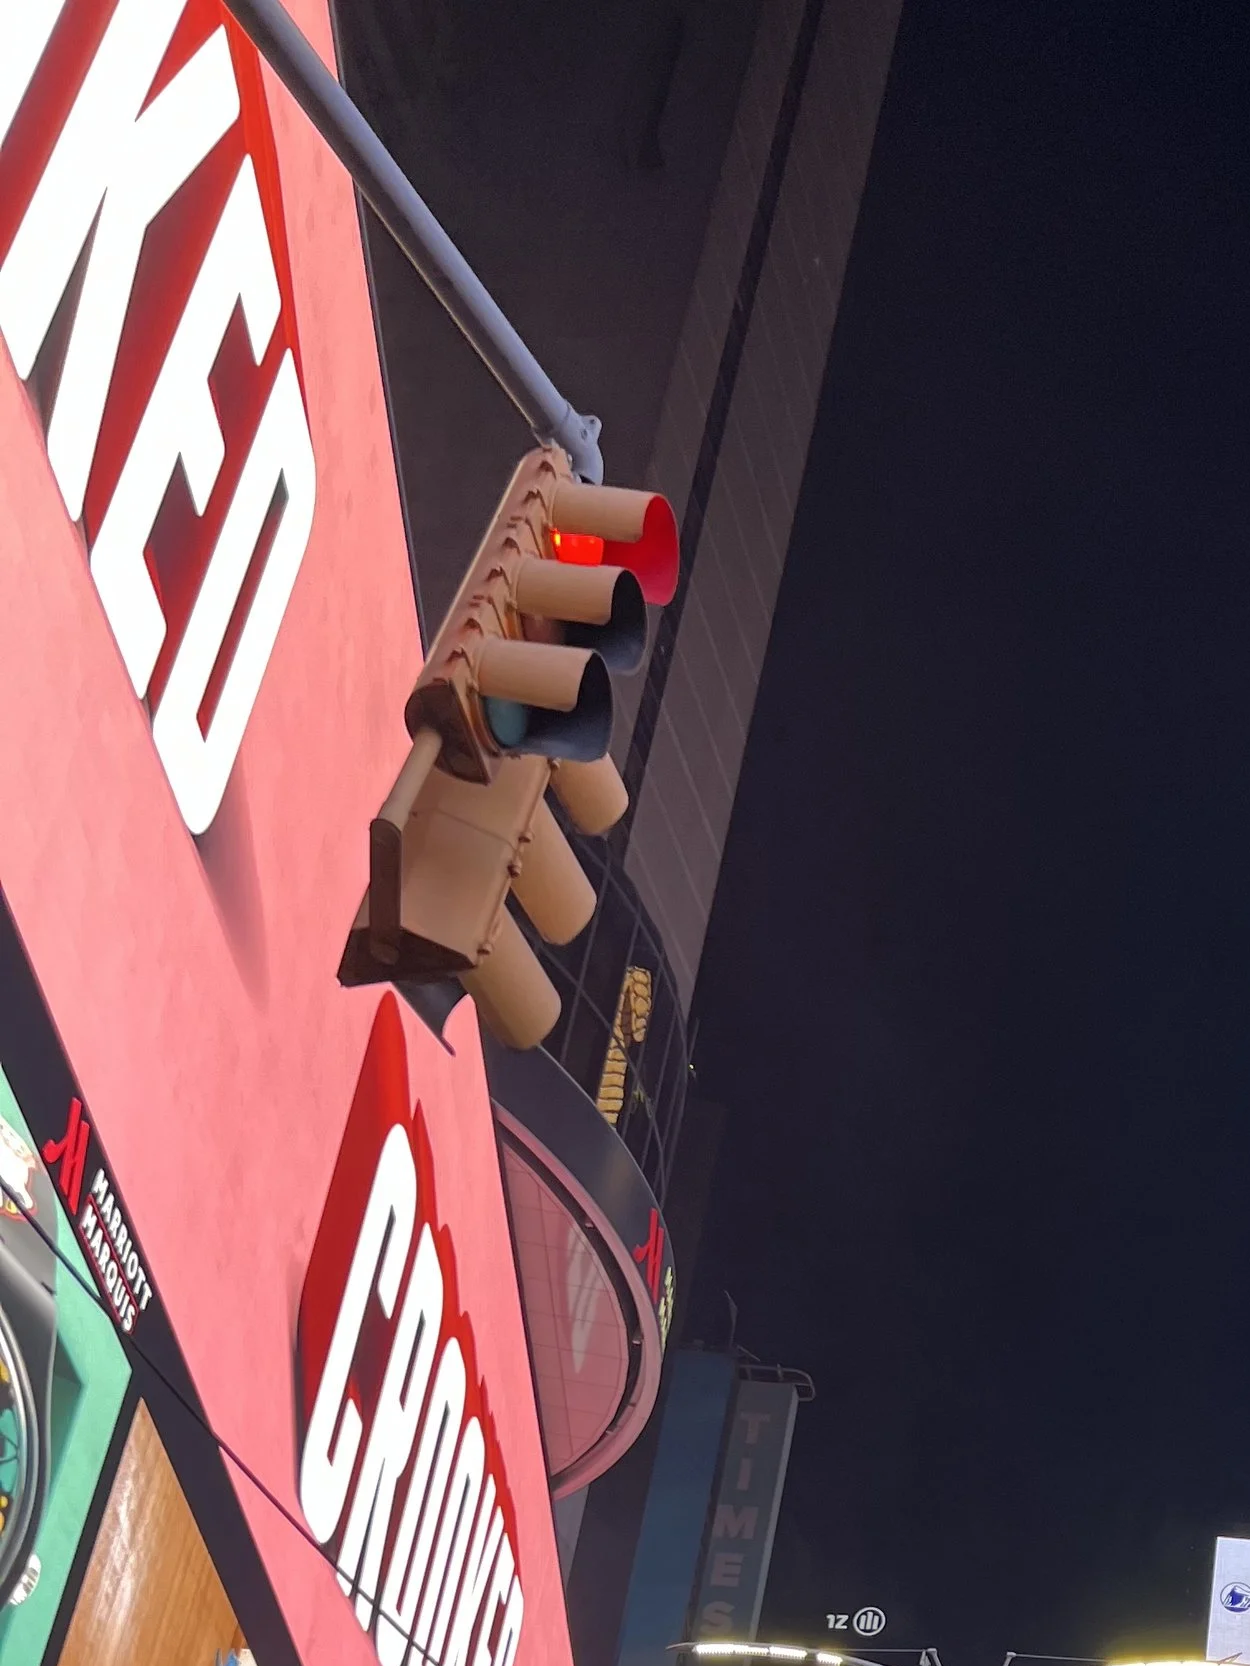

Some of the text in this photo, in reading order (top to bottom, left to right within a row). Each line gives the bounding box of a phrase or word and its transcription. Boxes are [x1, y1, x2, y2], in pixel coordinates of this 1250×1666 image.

[81, 1204, 136, 1334] MARQUIS
[90, 1168, 152, 1311] MARRIOTT
[700, 1411, 771, 1640] TIMES
